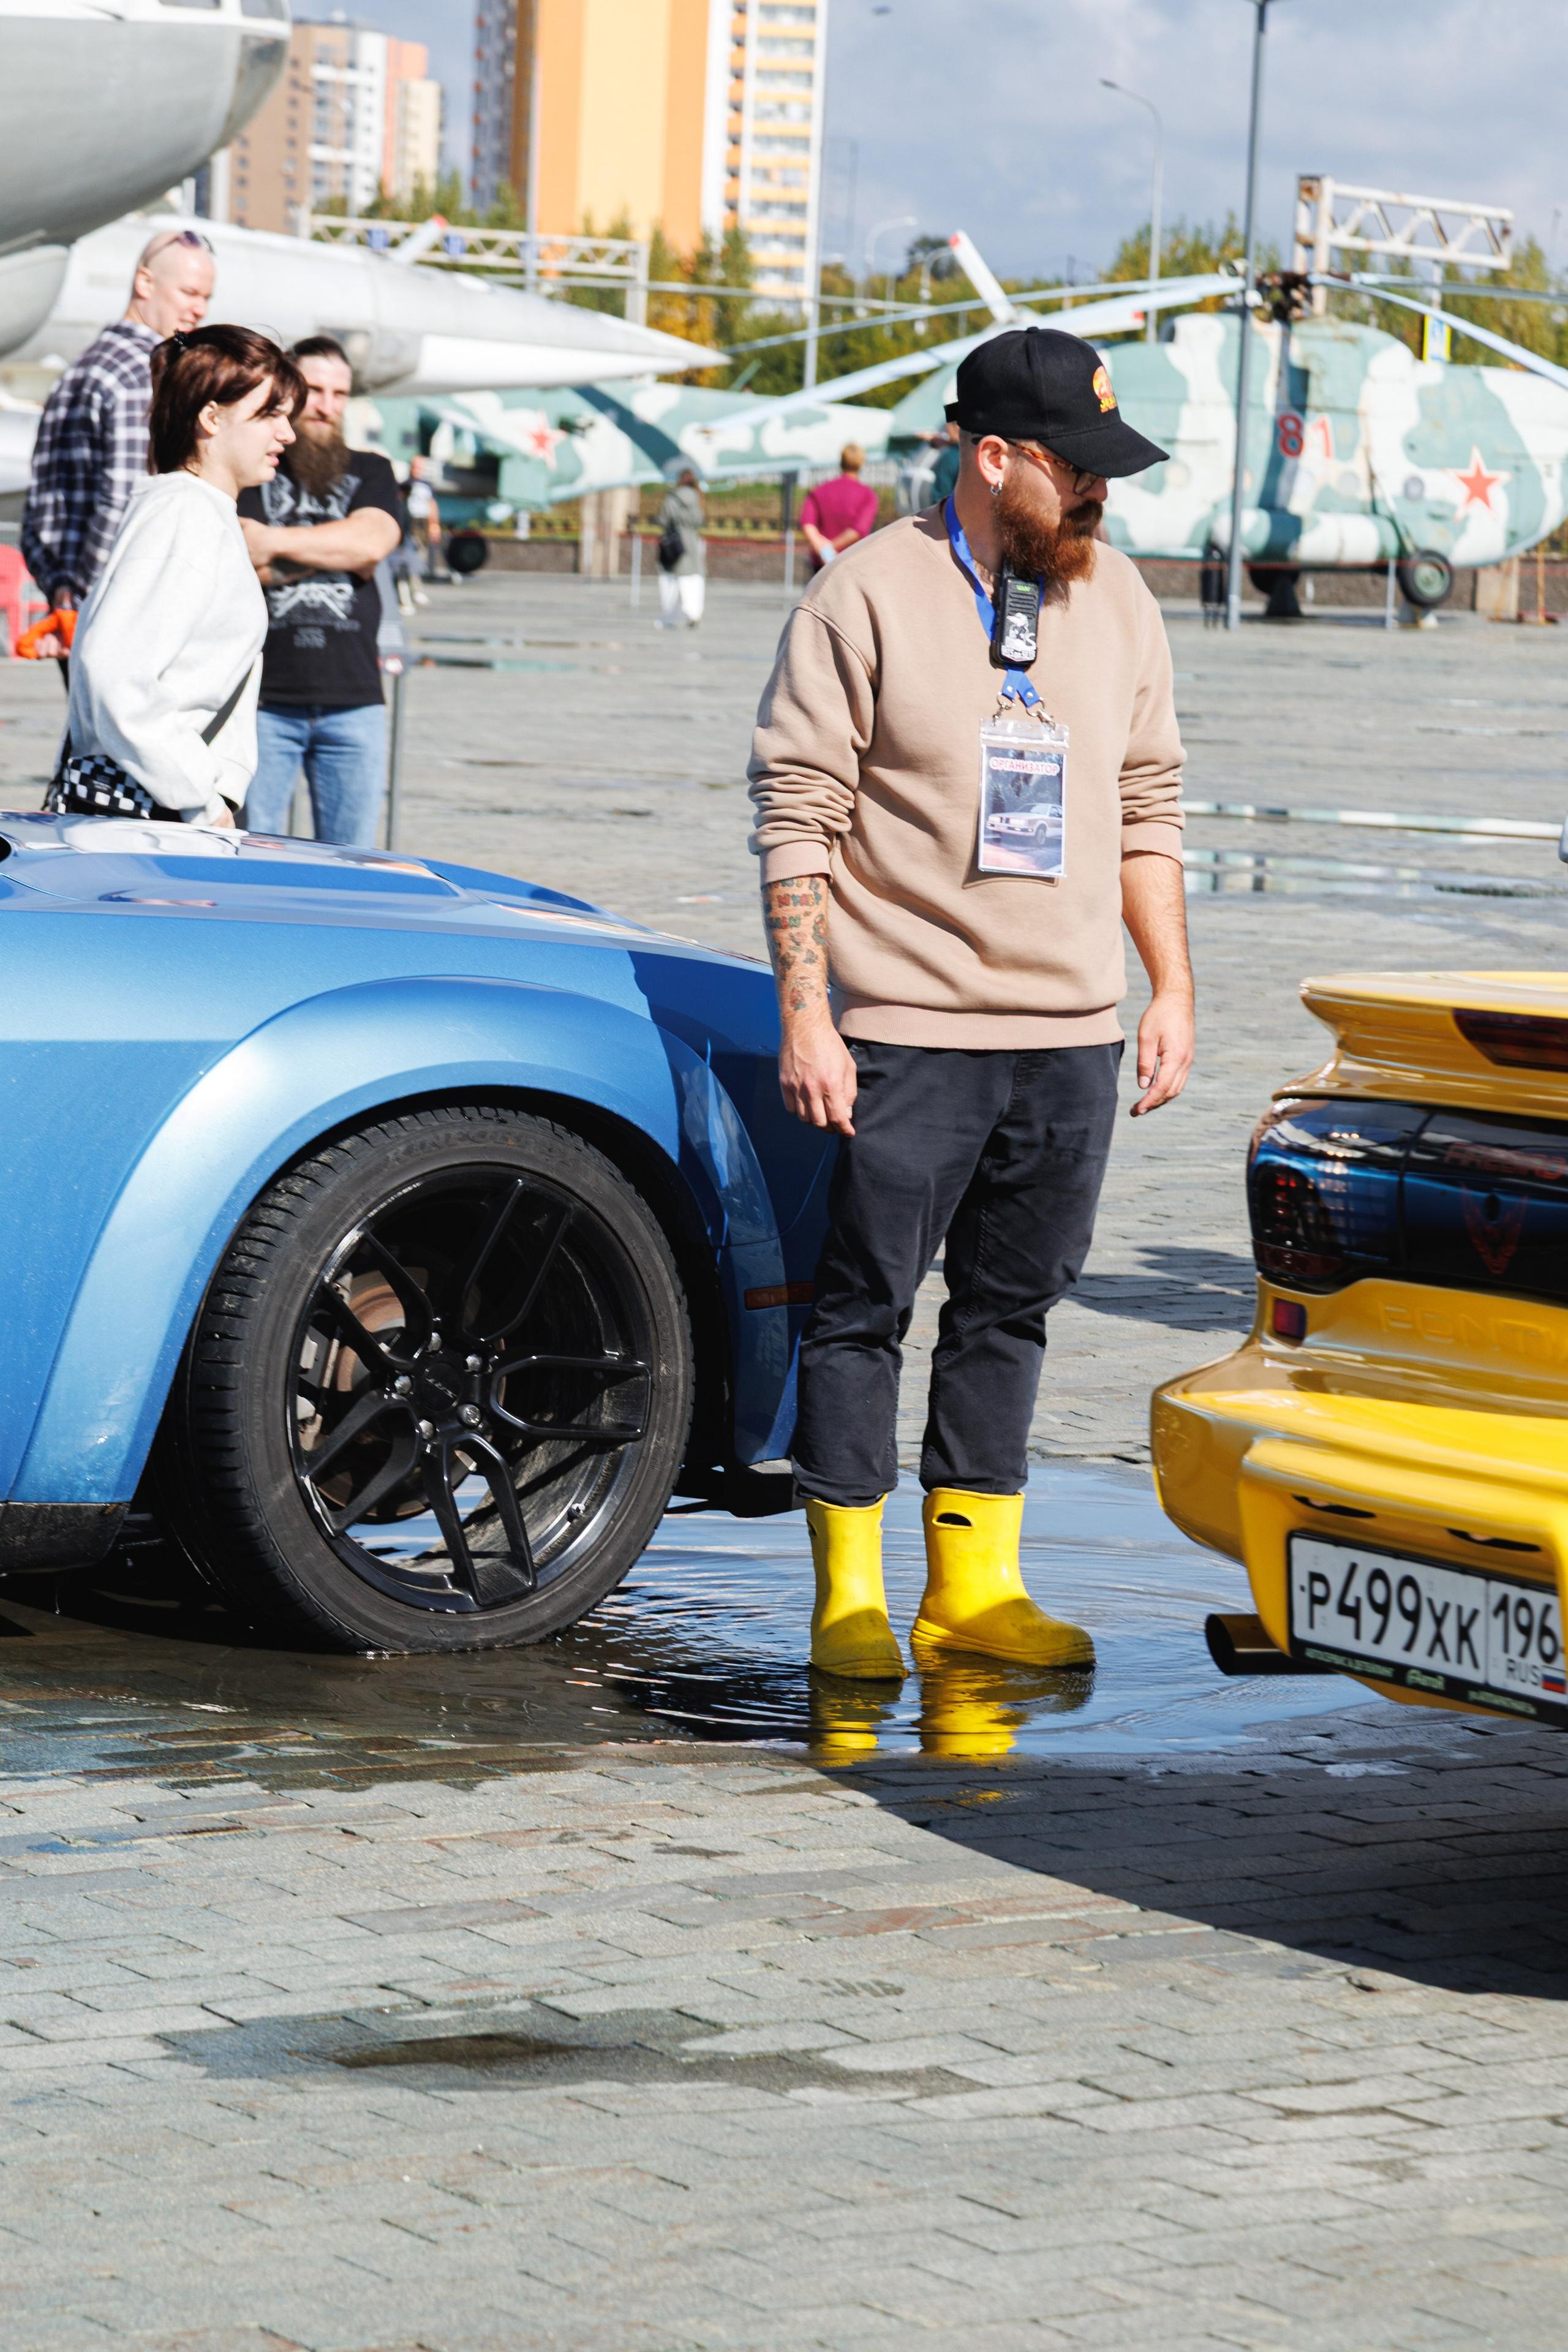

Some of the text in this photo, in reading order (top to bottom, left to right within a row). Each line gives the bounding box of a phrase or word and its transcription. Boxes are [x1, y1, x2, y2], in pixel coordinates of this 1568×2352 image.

[991, 759, 1058, 774] ОРГАНИЗАТОР
[1493, 1594, 1560, 1664] 196
[1506, 1657, 1541, 1686] RUS
